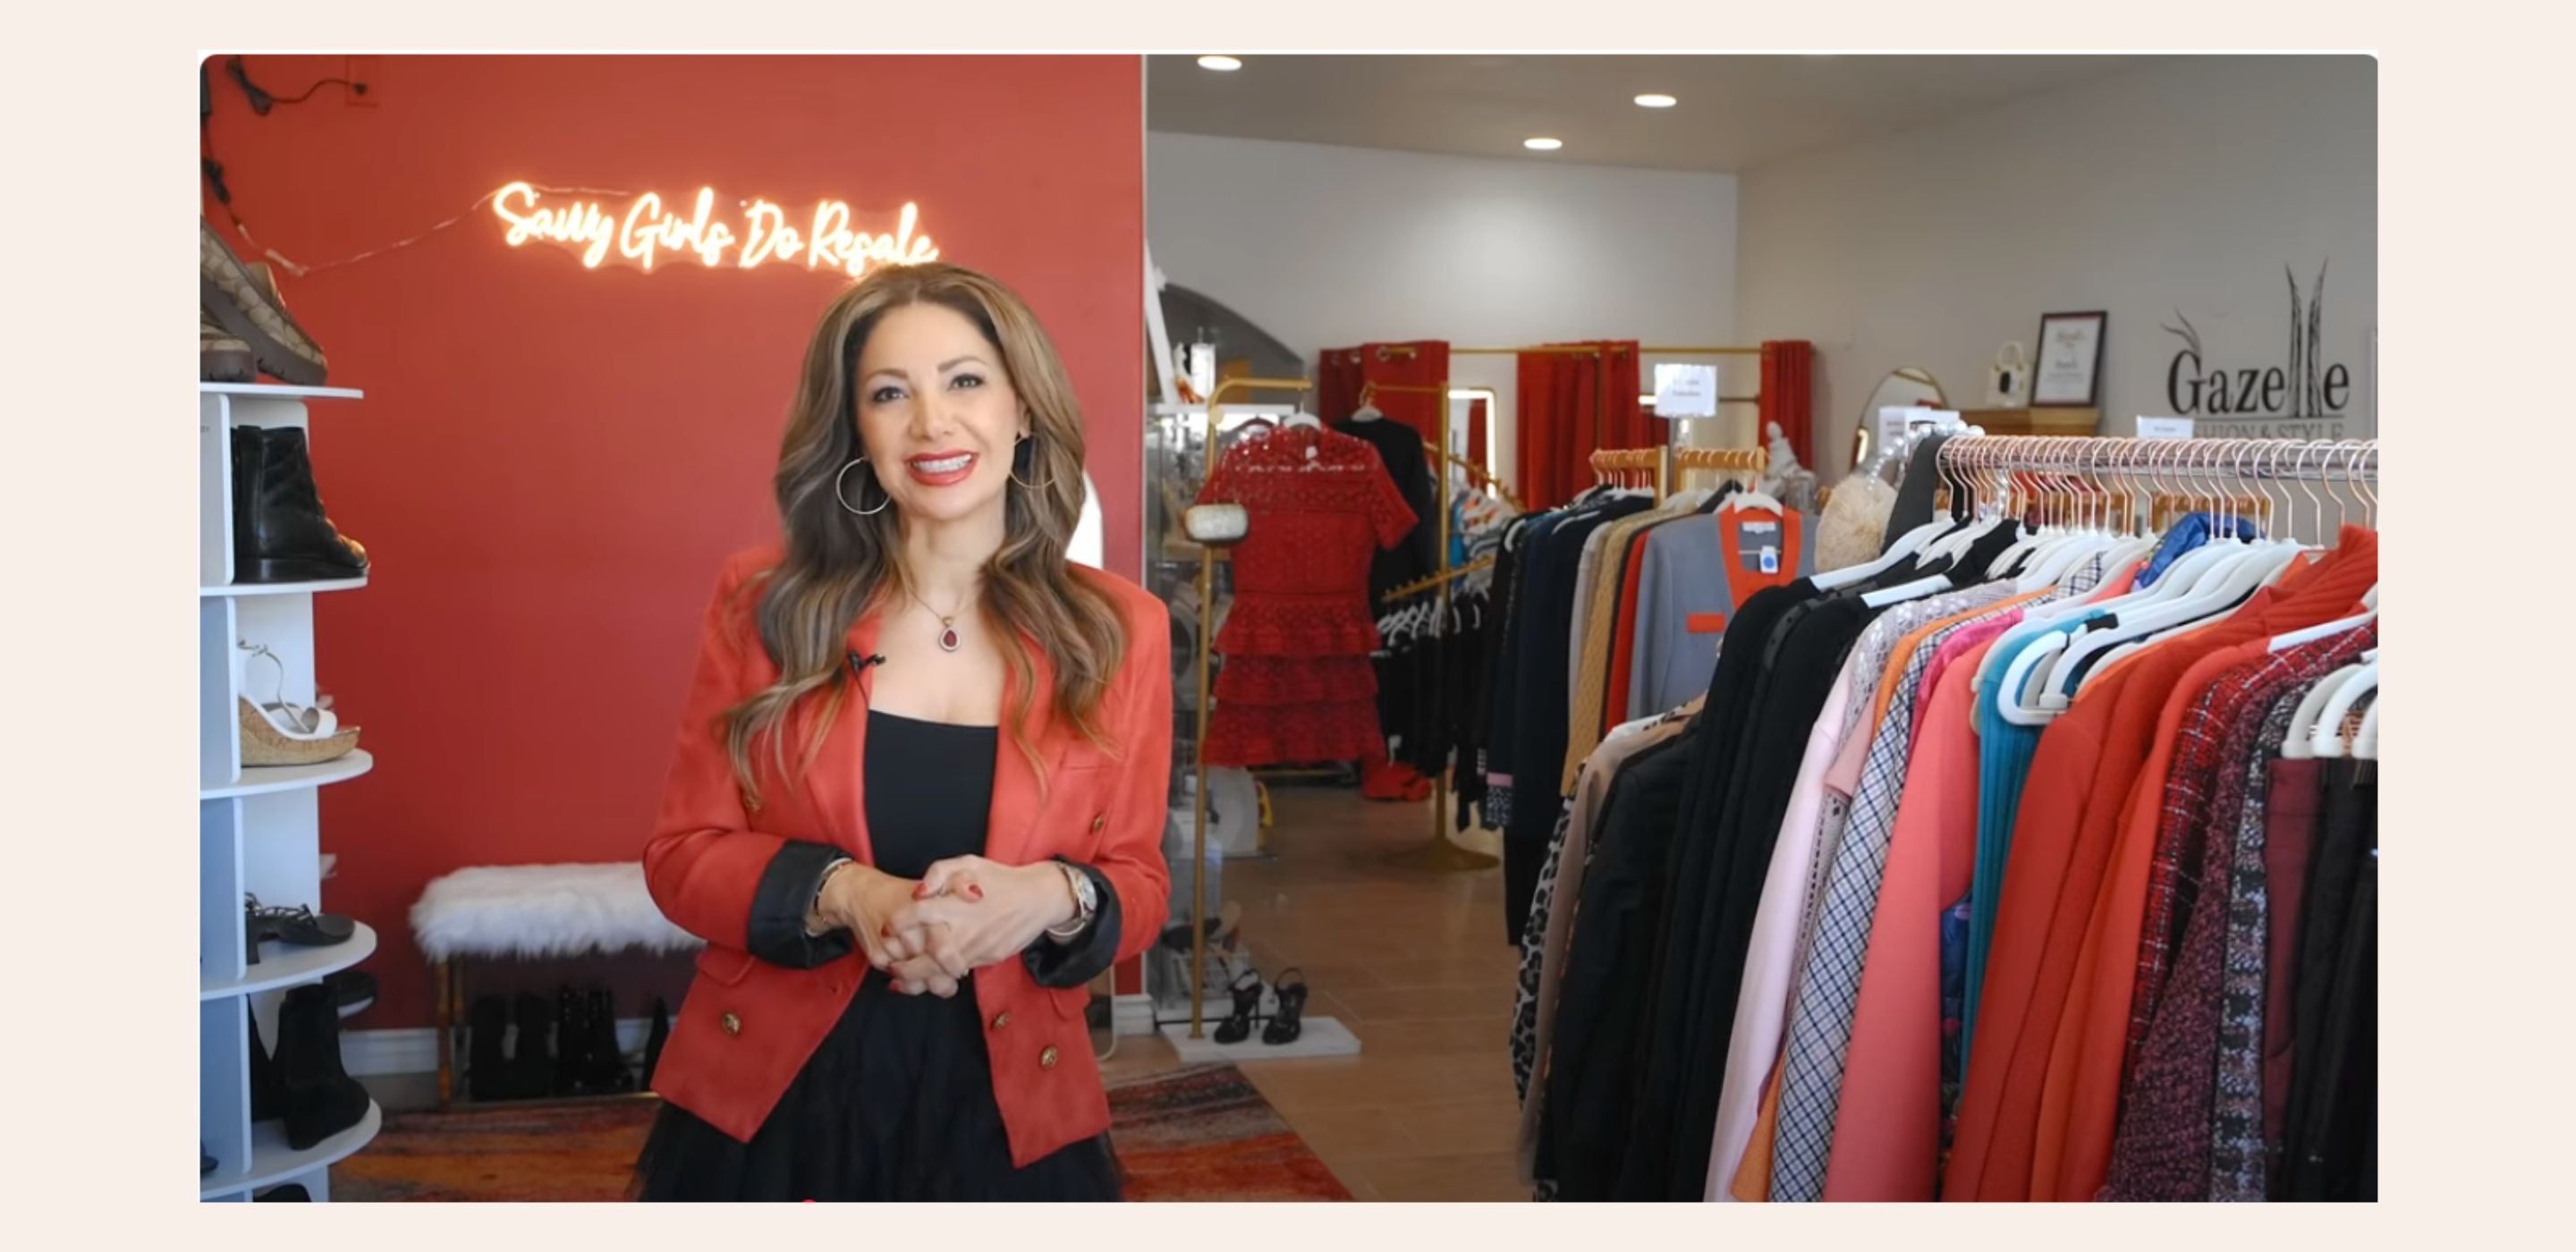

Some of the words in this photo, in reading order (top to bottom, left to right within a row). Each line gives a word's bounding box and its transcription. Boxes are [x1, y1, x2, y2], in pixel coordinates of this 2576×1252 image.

[493, 182, 614, 268] Savvy
[619, 186, 735, 273] Girls
[738, 199, 803, 268] Do
[807, 199, 939, 278] Resale
[2160, 257, 2350, 418] Gazelle
[2277, 422, 2344, 440] STYLE
